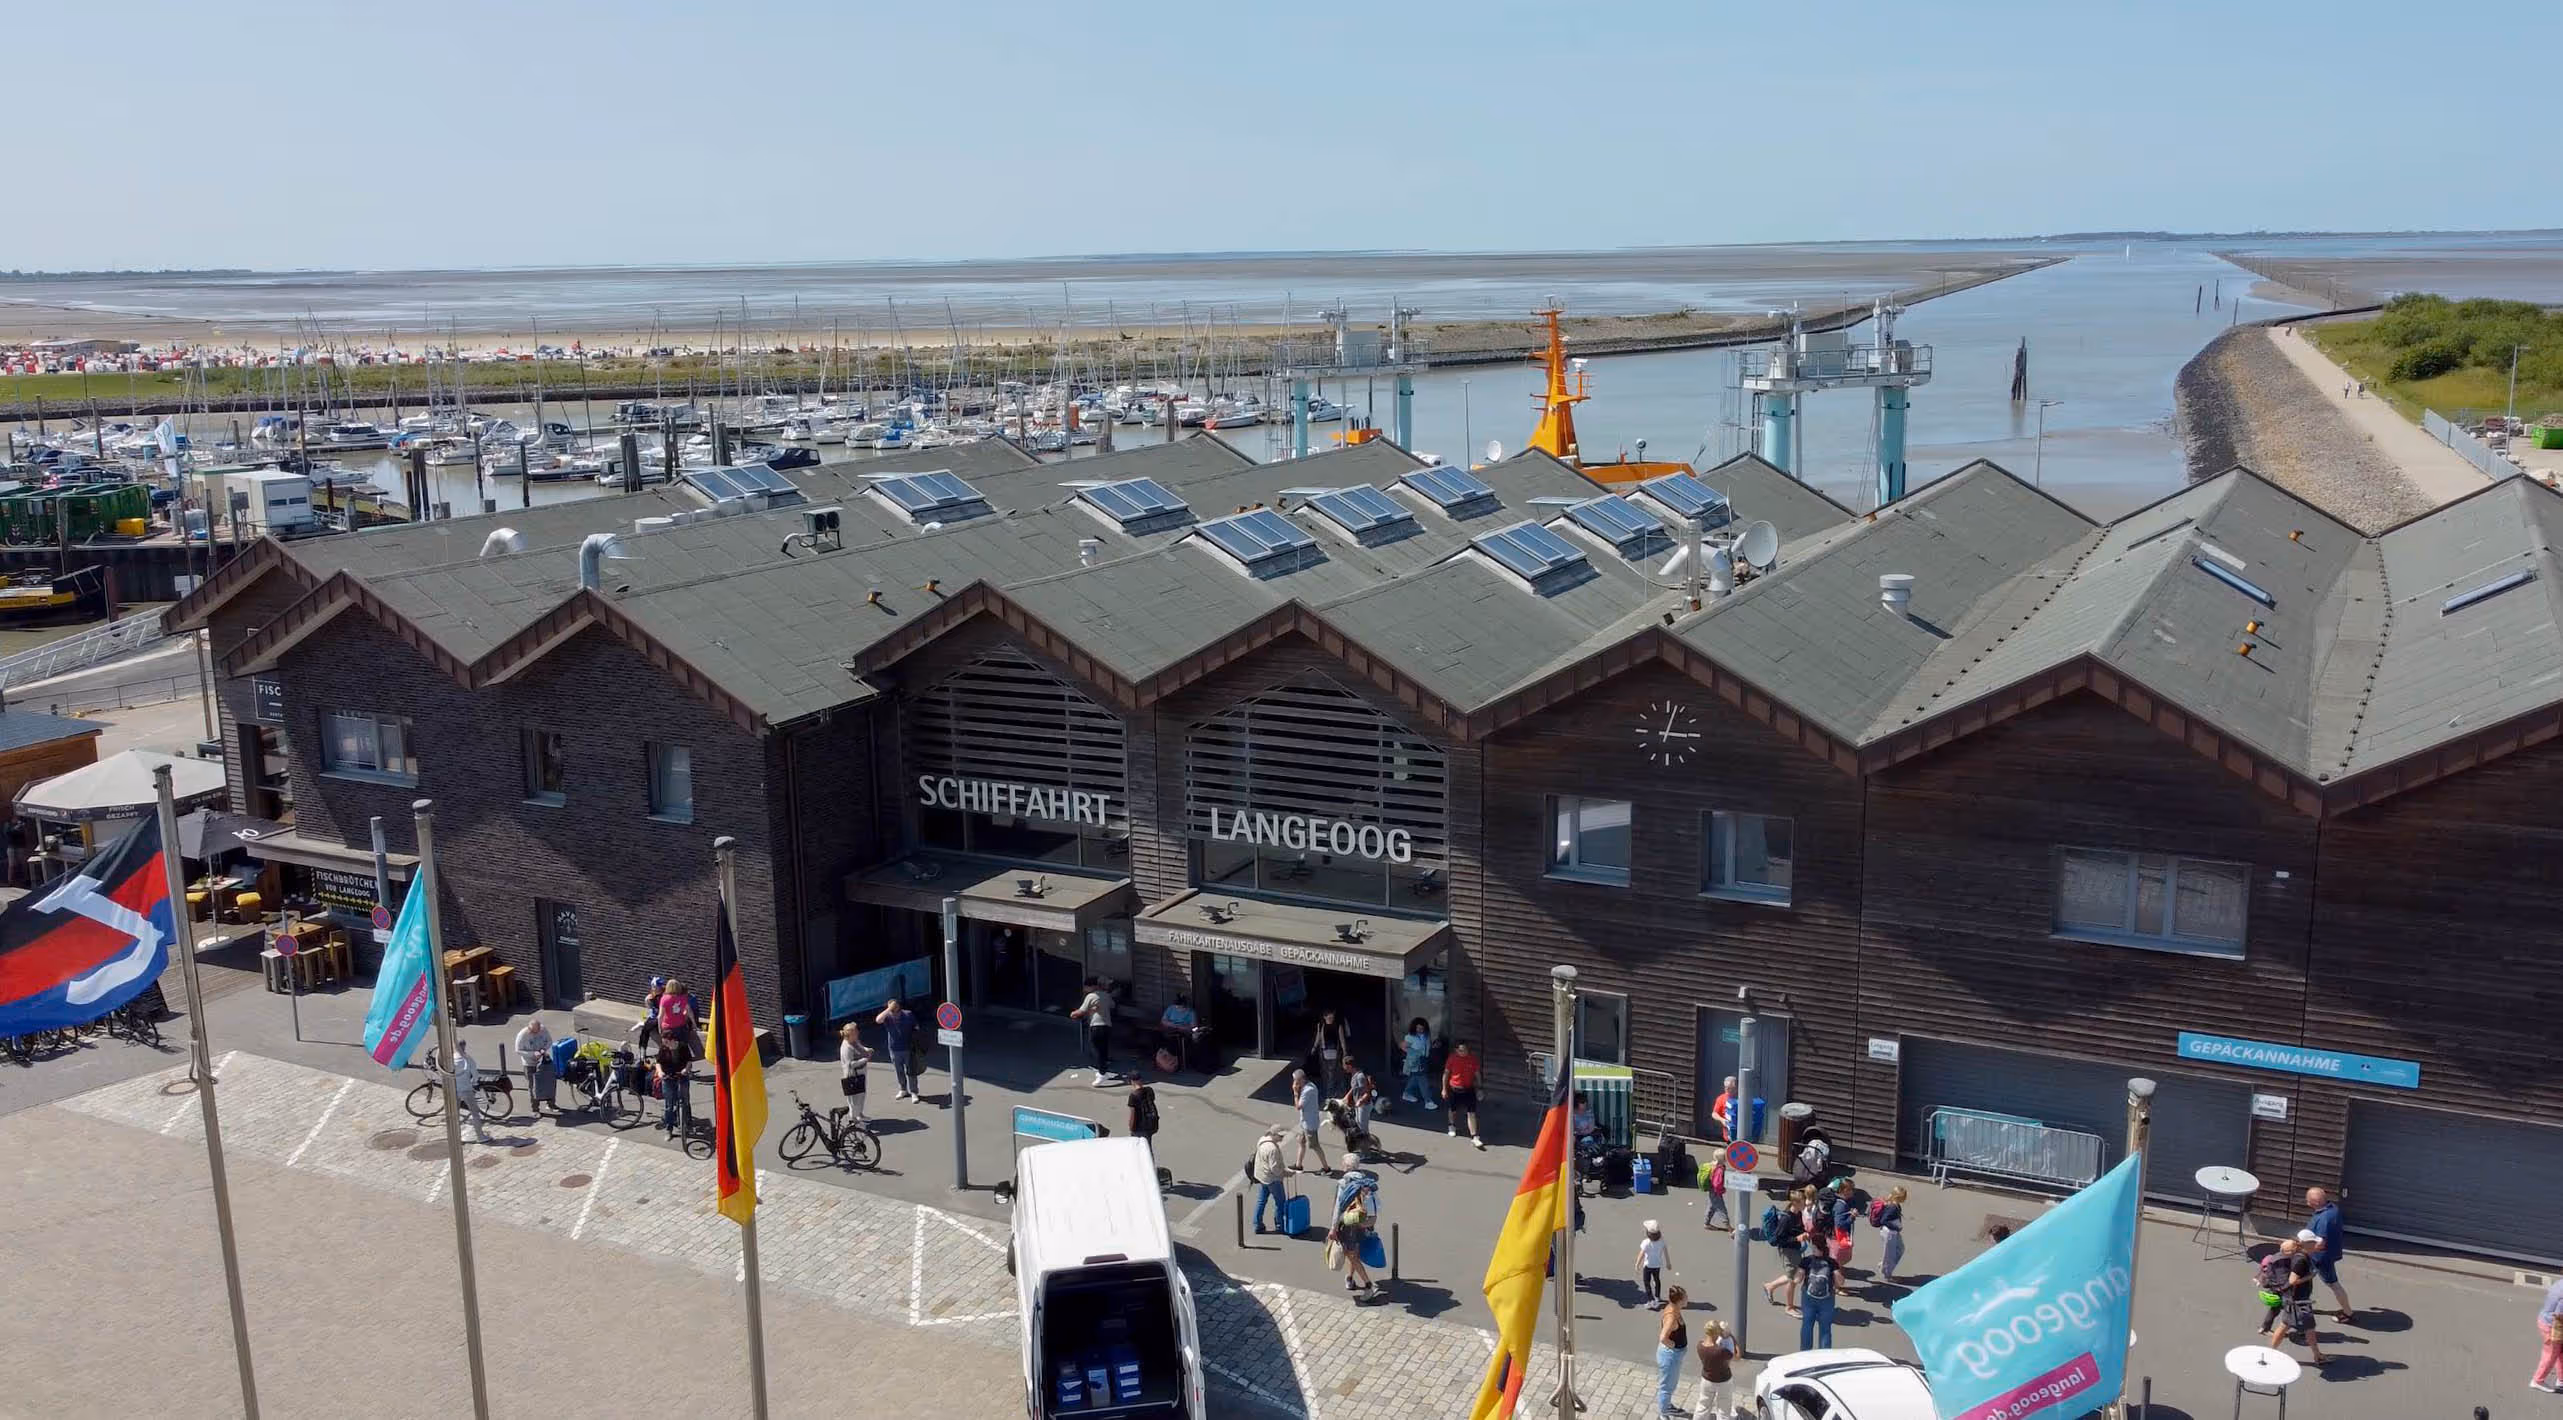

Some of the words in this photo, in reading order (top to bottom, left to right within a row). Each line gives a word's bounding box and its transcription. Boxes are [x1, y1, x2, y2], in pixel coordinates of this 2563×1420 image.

[919, 775, 1111, 825] SCHIFFAHRT
[1211, 807, 1412, 863] LANGEOOG
[340, 886, 370, 897] LANGEOOG
[1168, 930, 1273, 956] FAHRKARTENAUSGABE
[1280, 946, 1370, 970] GEPÄCKANNAHME
[2189, 1040, 2341, 1072] GEPÄCKANNAHME
